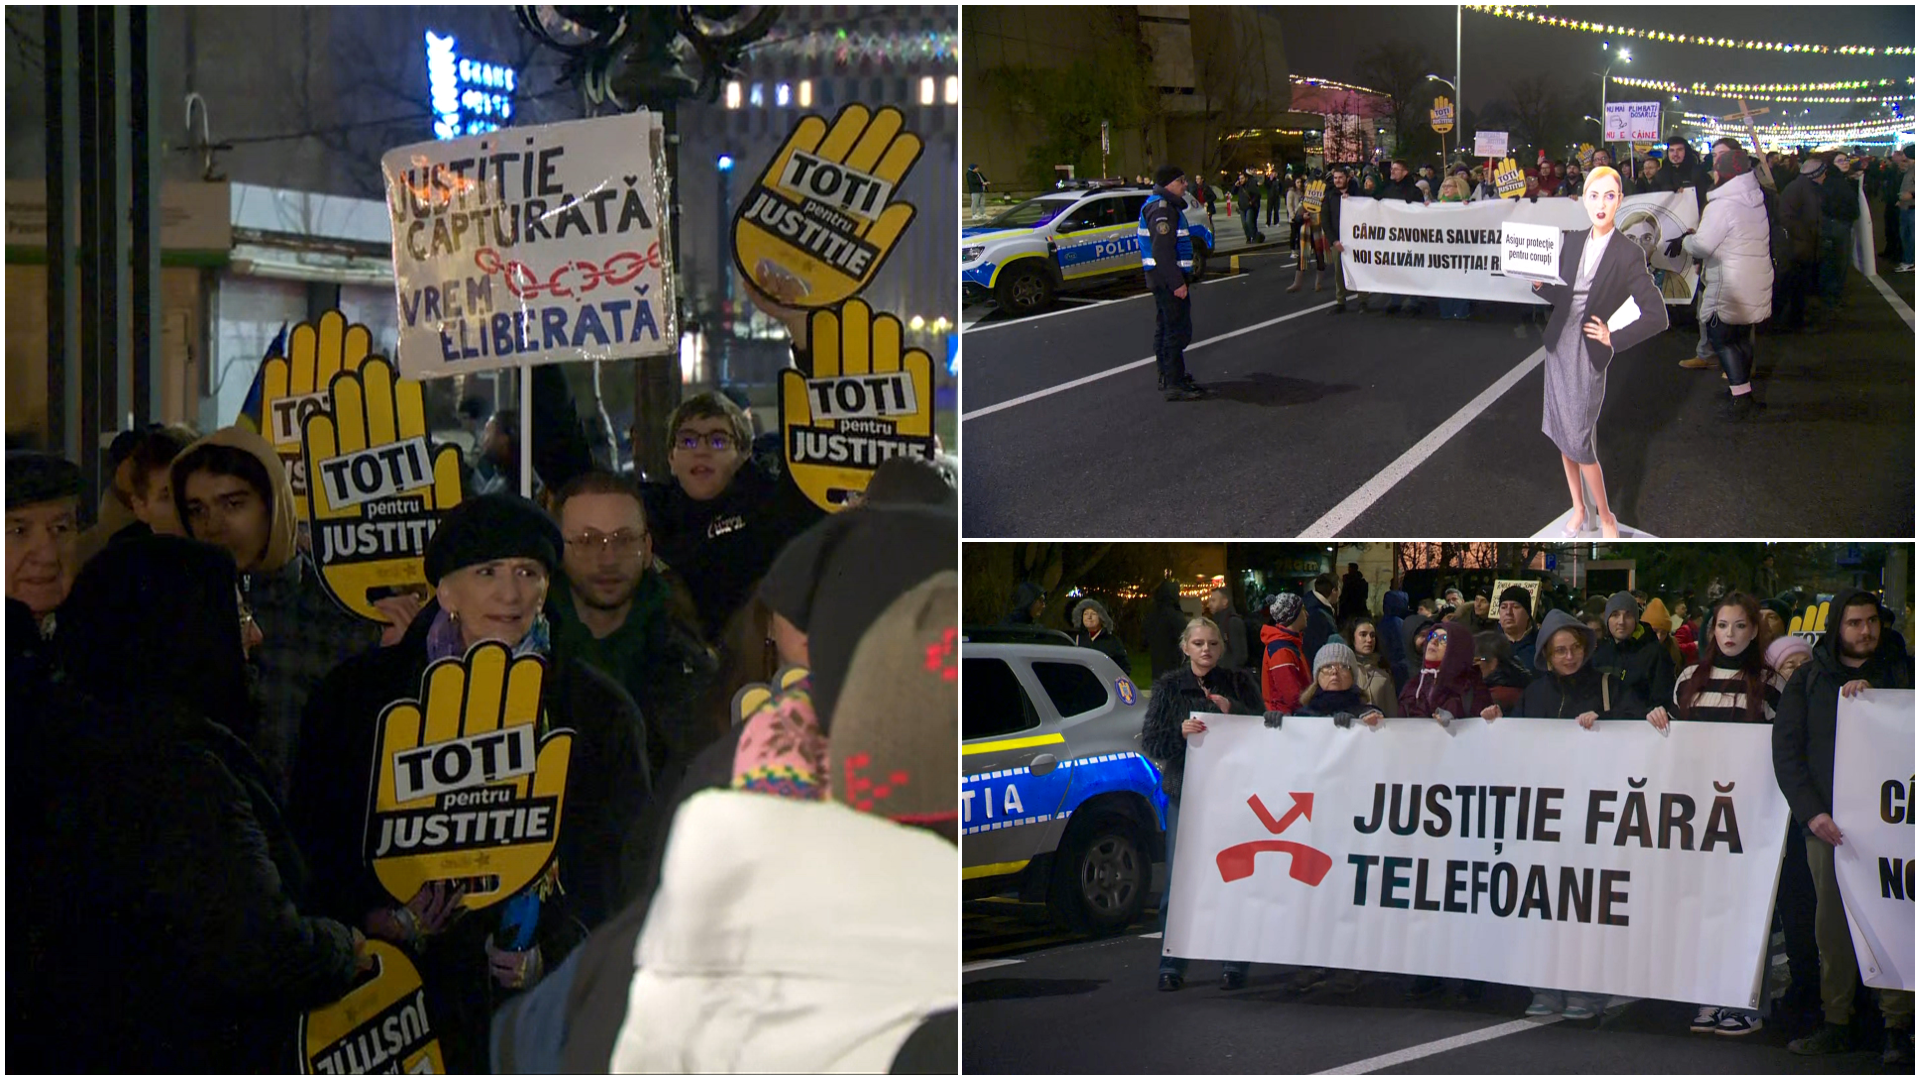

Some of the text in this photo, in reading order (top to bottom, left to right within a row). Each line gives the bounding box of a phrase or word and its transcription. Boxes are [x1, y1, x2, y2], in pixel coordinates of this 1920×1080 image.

[793, 153, 882, 213] TOȚI
[406, 174, 653, 261] CAPTURATĂ
[744, 192, 872, 276] JUSTIȚIE
[803, 200, 852, 232] pentru
[1352, 223, 1386, 240] CÂND
[1388, 227, 1444, 244] SAVONEA
[1353, 249, 1372, 265] NOI
[1374, 250, 1425, 268] SALVĂM
[1428, 254, 1488, 273] JUSTIȚIA!
[1505, 233, 1554, 252] Asigur protecție
[1508, 249, 1552, 266] pentru corupți
[401, 274, 493, 328] VREM
[440, 283, 660, 363] ELIBERATĂ
[808, 376, 906, 416] TOȚI
[840, 418, 892, 436] pentru
[323, 443, 423, 501] TOȚI
[367, 500, 419, 519] pentru
[397, 731, 522, 792] TOȚI
[443, 788, 510, 811] pentru
[1353, 777, 1744, 856] JUSTIȚIE FĂRĂ
[376, 806, 550, 858] JUSTIȚIE
[1347, 853, 1631, 927] TELEFOANE
